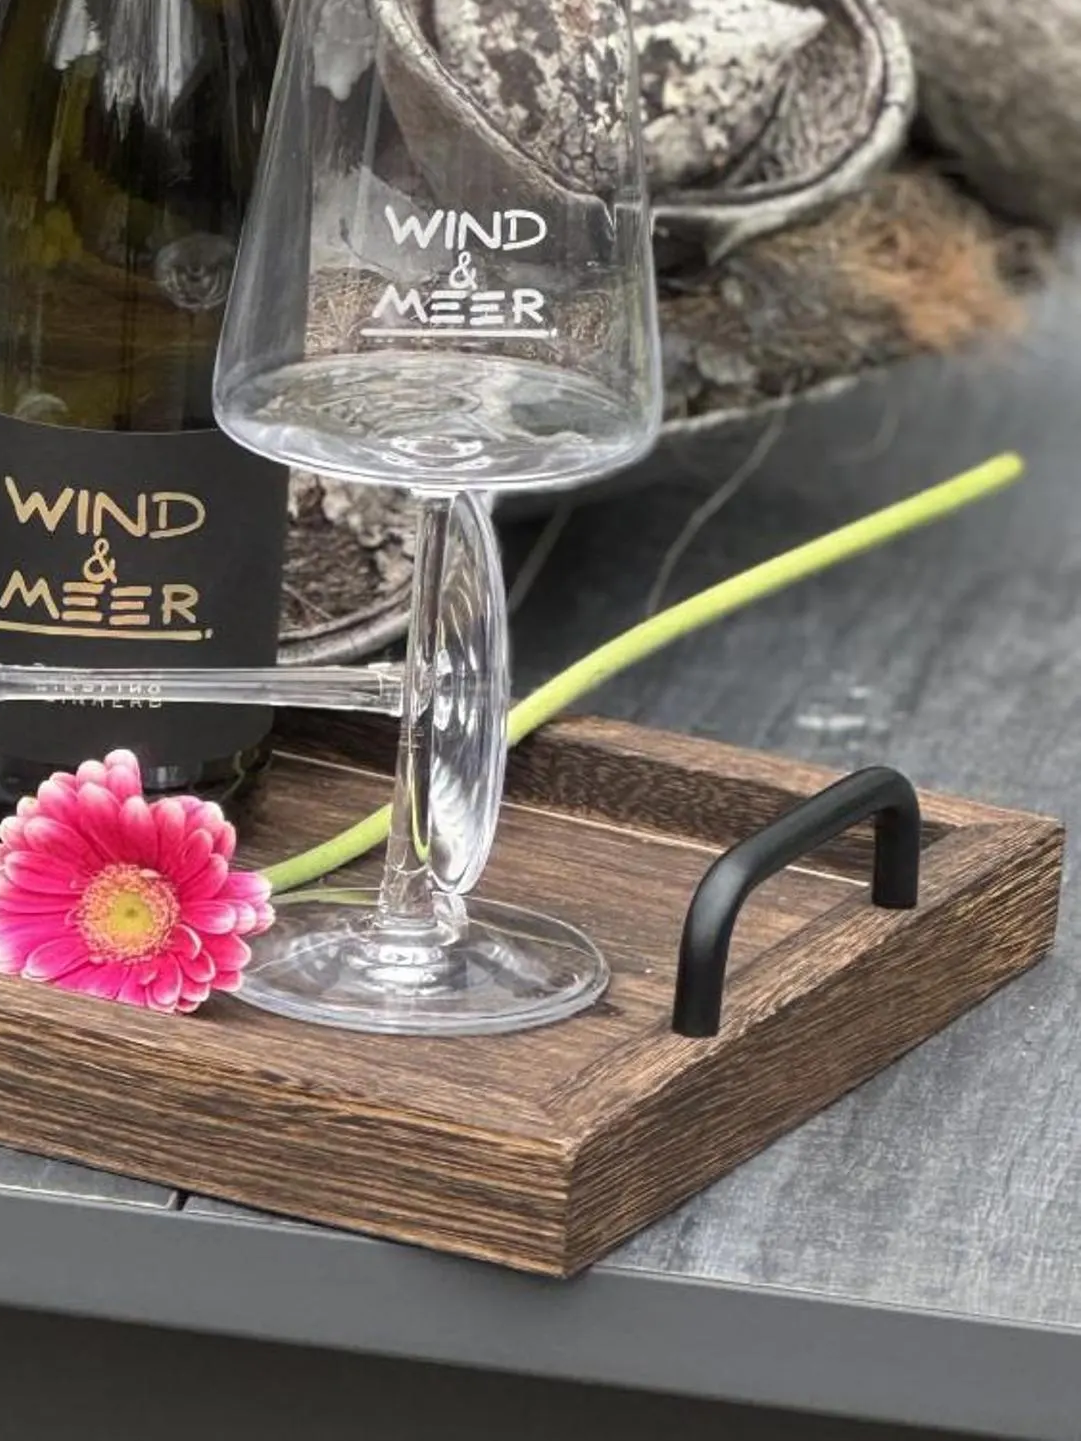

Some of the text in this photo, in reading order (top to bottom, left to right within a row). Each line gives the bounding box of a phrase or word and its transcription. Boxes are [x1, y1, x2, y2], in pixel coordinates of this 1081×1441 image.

[384, 204, 548, 251] WIND
[448, 250, 478, 291] &
[4, 475, 206, 539] WIND
[82, 537, 118, 584] &
